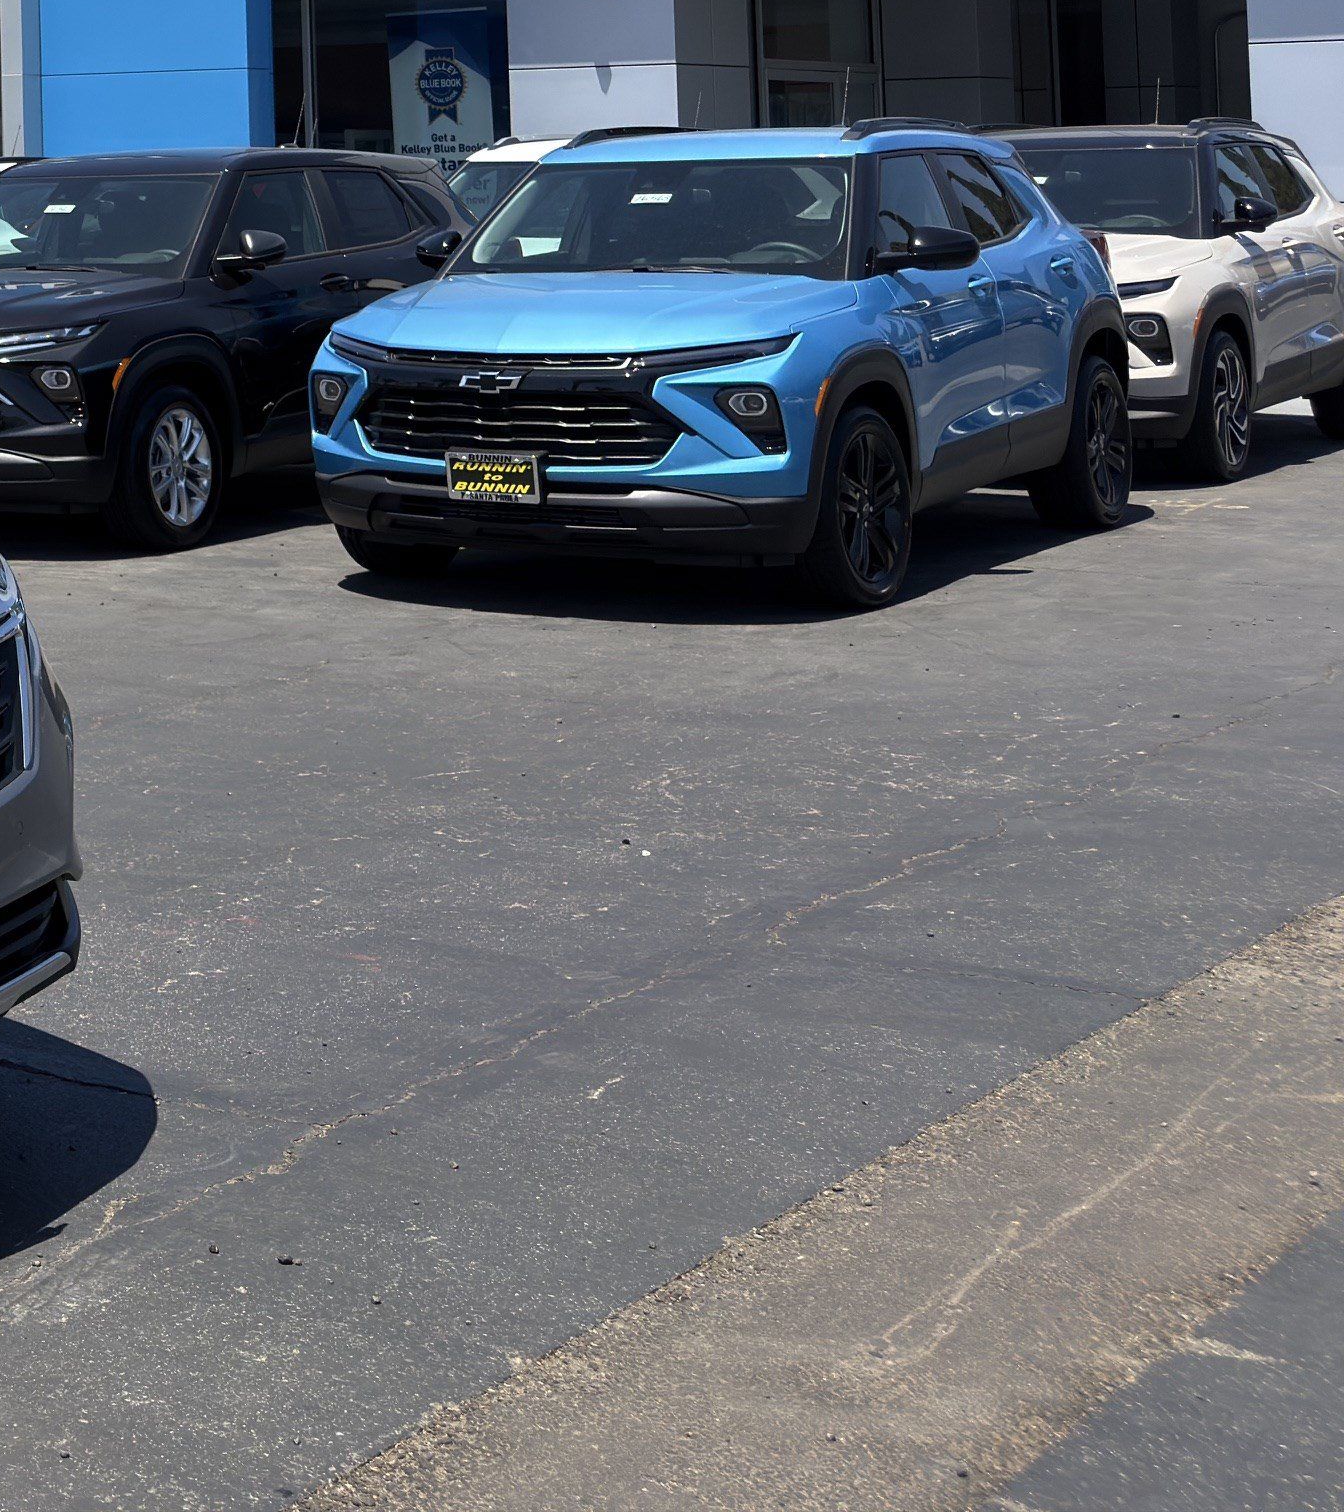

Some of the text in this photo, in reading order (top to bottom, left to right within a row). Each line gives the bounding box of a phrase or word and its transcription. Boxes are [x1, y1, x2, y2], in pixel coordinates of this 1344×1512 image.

[424, 61, 459, 77] KELLEY
[419, 77, 462, 89] BLUE BOOK
[431, 133, 456, 143] Get a
[401, 144, 432, 155] Kelley
[433, 143, 456, 154] Blue
[468, 453, 512, 464] BUNNIN
[452, 461, 531, 473] RUNNIN'
[483, 473, 504, 481] to
[454, 481, 531, 494] BUNNIN
